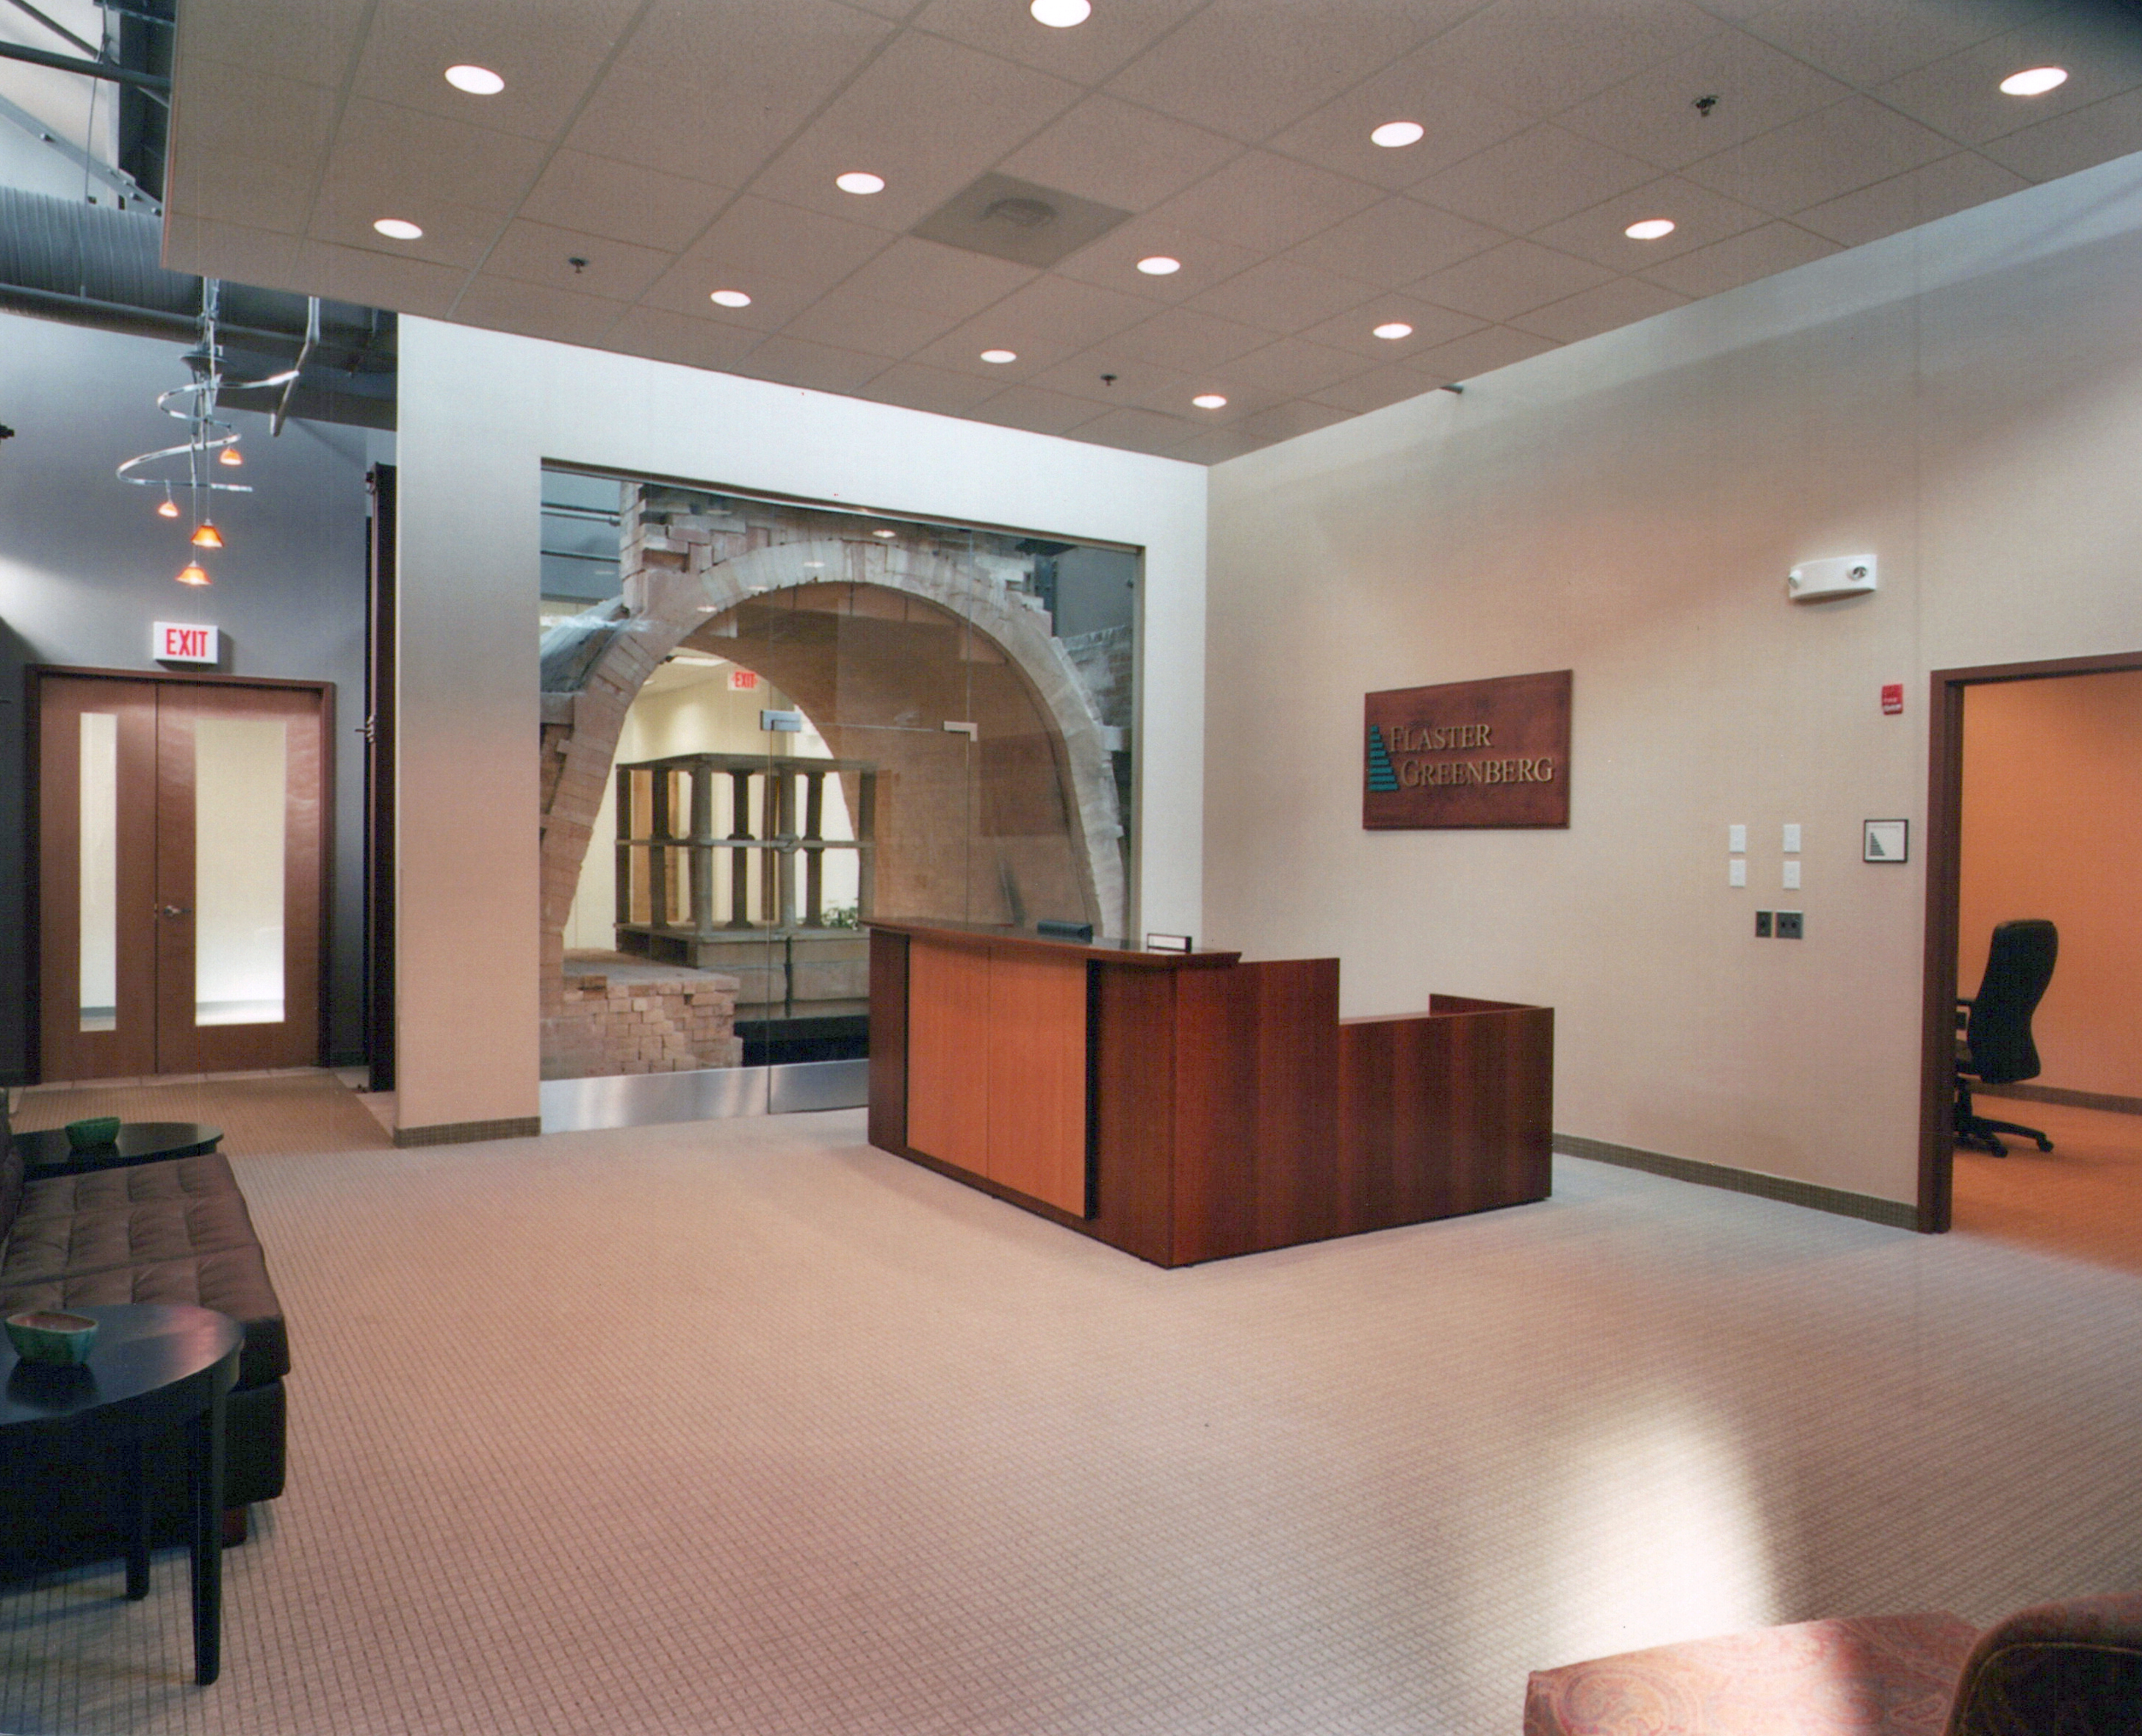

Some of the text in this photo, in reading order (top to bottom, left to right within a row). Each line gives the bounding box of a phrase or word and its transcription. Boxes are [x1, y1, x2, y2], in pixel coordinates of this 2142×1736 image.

[166, 628, 208, 658] EXIT
[735, 671, 756, 688] EXIT
[1389, 724, 1491, 752] FLASTER
[1402, 757, 1554, 788] GREENBERG
